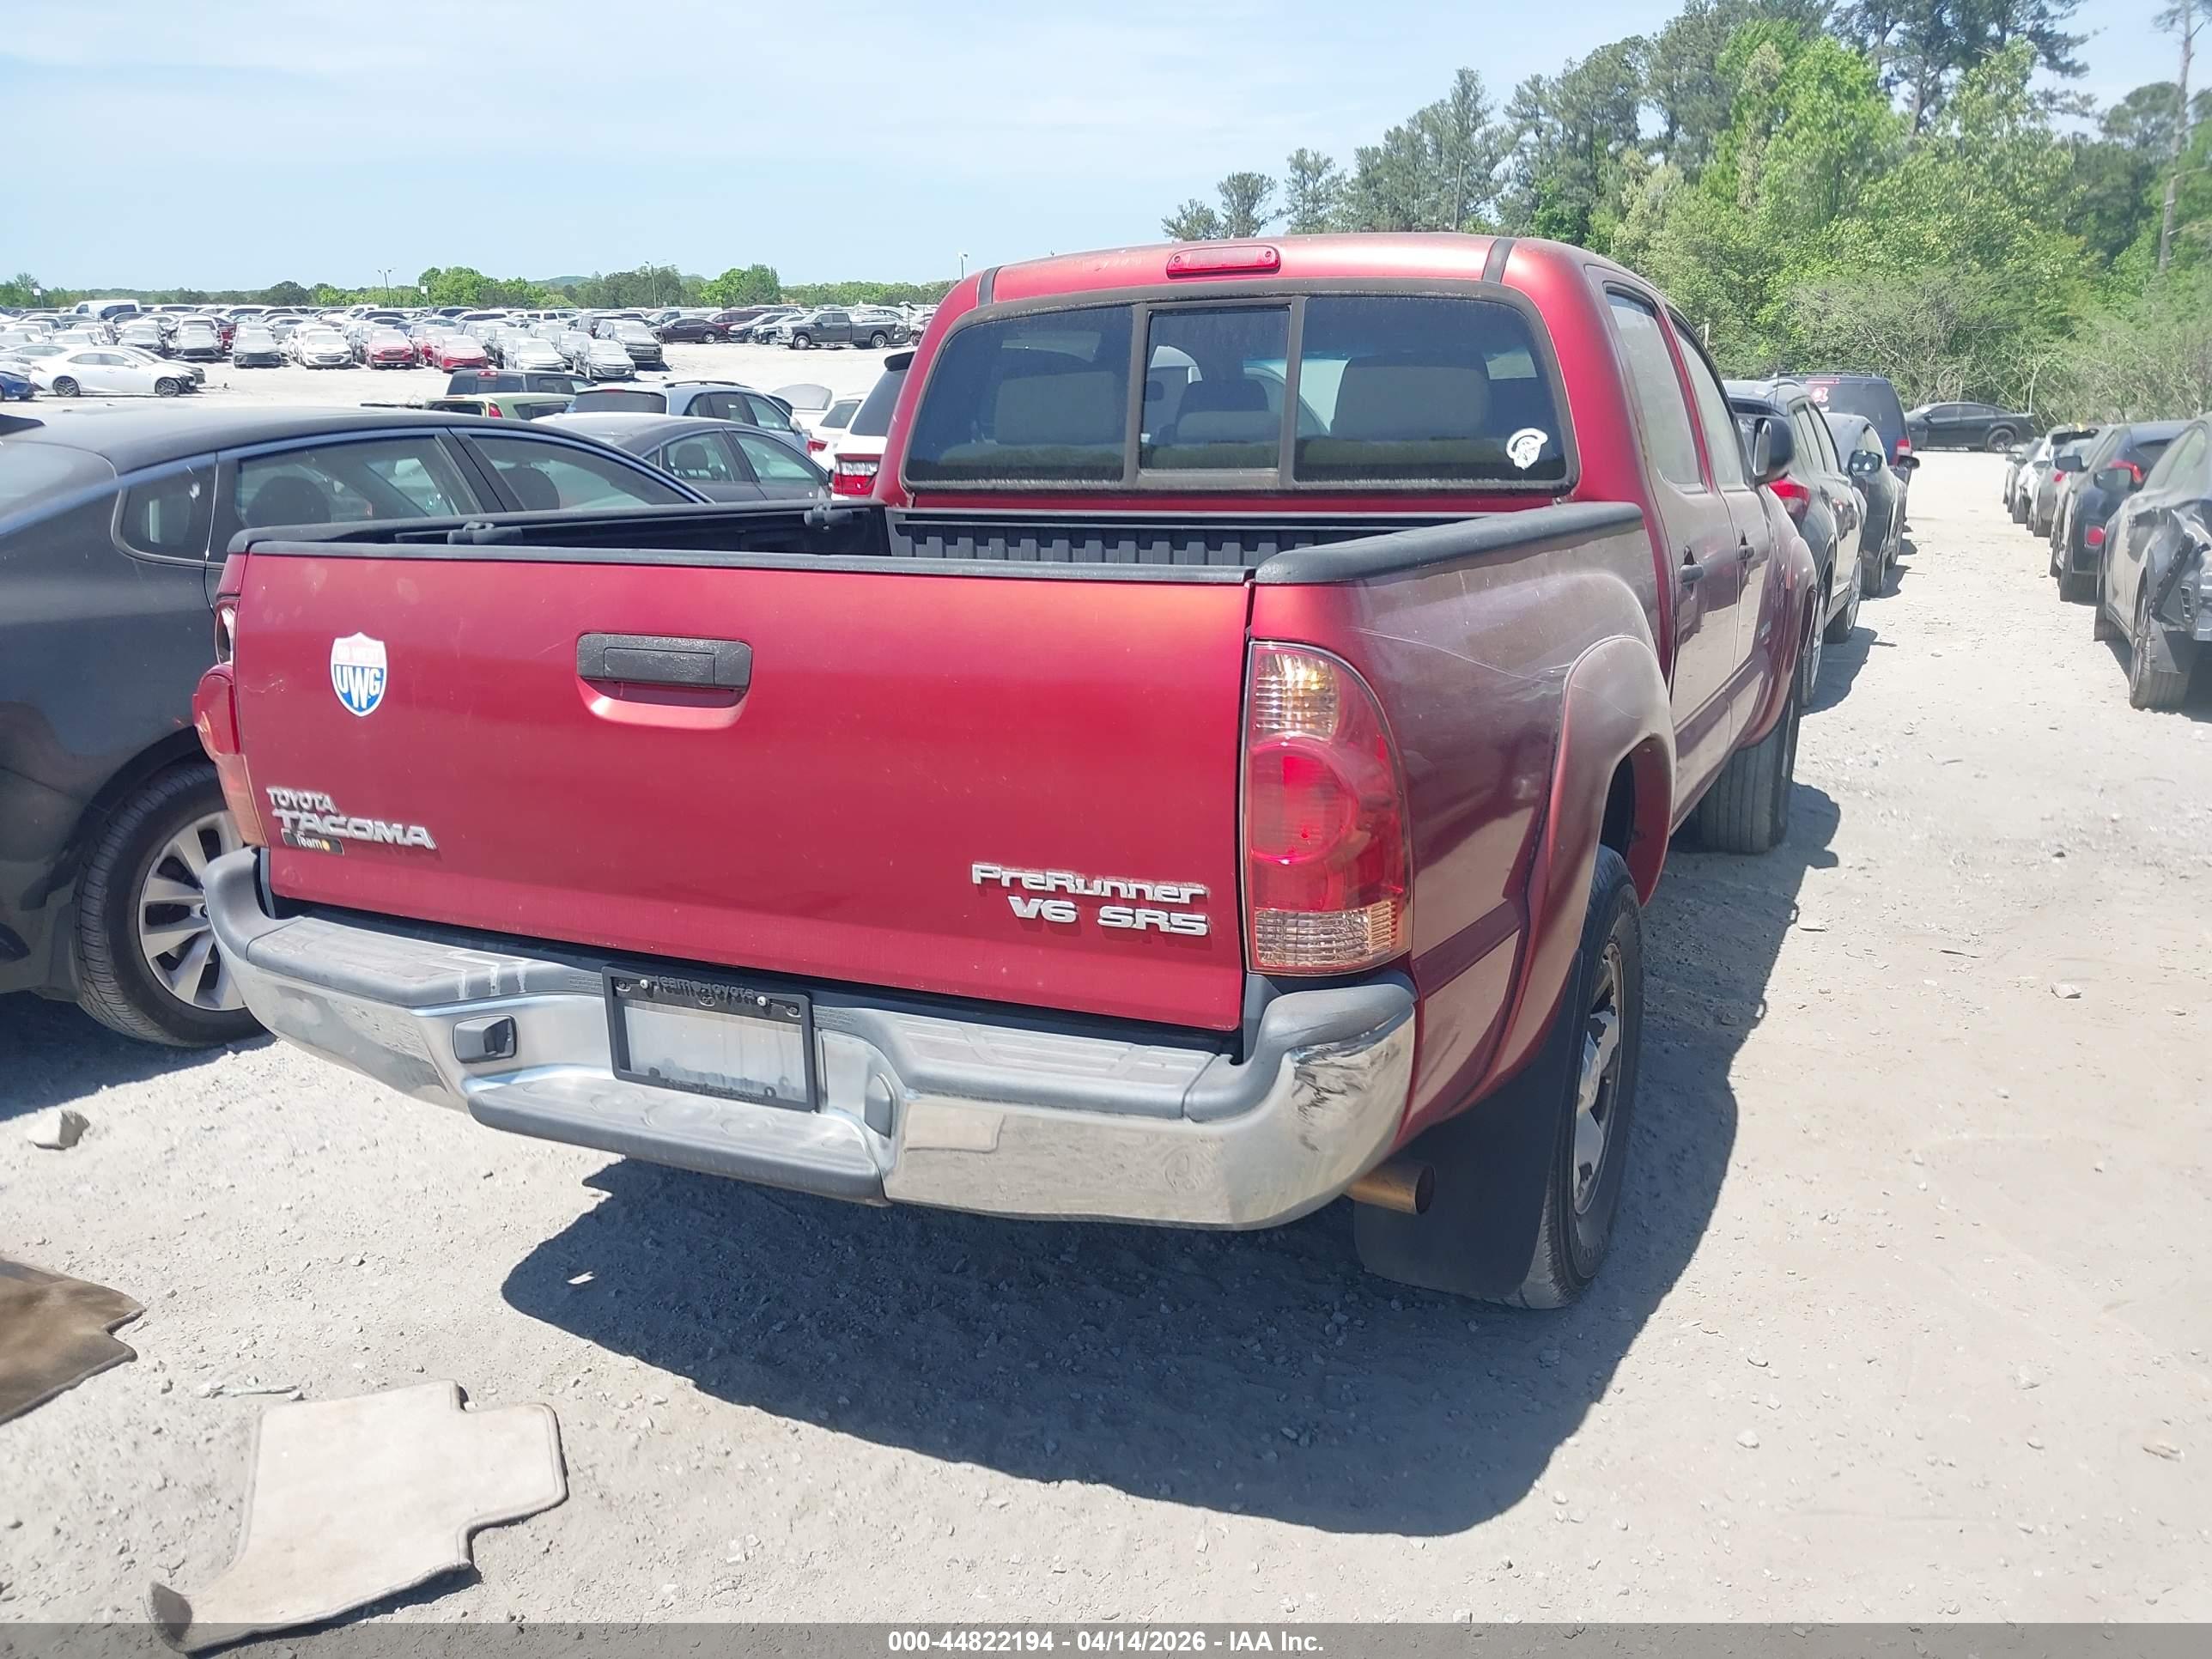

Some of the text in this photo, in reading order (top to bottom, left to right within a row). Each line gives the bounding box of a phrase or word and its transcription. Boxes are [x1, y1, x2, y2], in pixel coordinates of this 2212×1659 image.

[335, 665, 383, 709] UWG
[266, 787, 338, 815] TOYOTA
[271, 808, 436, 850] TACOMA
[294, 830, 323, 851] Team
[971, 862, 1209, 904] PreRunner
[1007, 896, 1209, 936] V6 SR5
